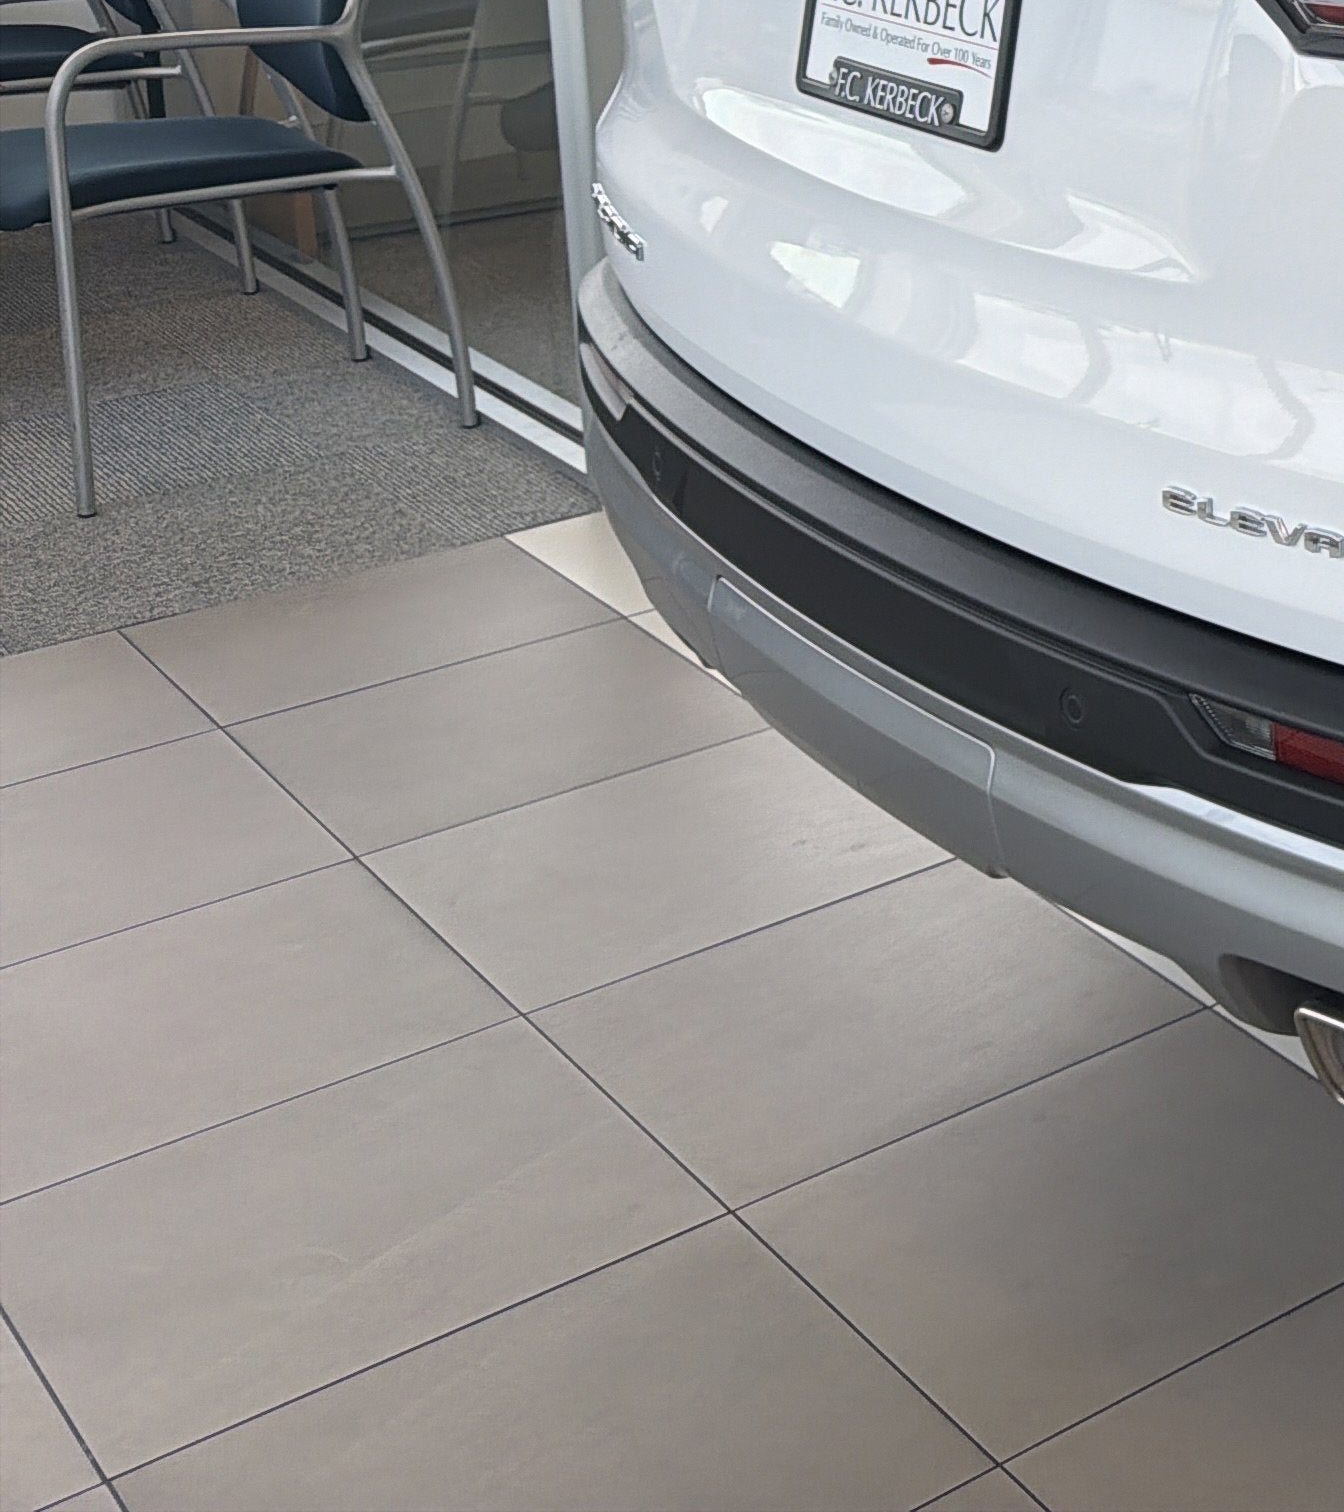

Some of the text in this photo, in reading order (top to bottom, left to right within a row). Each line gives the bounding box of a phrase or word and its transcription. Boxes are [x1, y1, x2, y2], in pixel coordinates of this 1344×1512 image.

[821, 12, 992, 70] Family Owned & Operated For Over 100 Years
[835, 68, 944, 126] F.C. KERBECK
